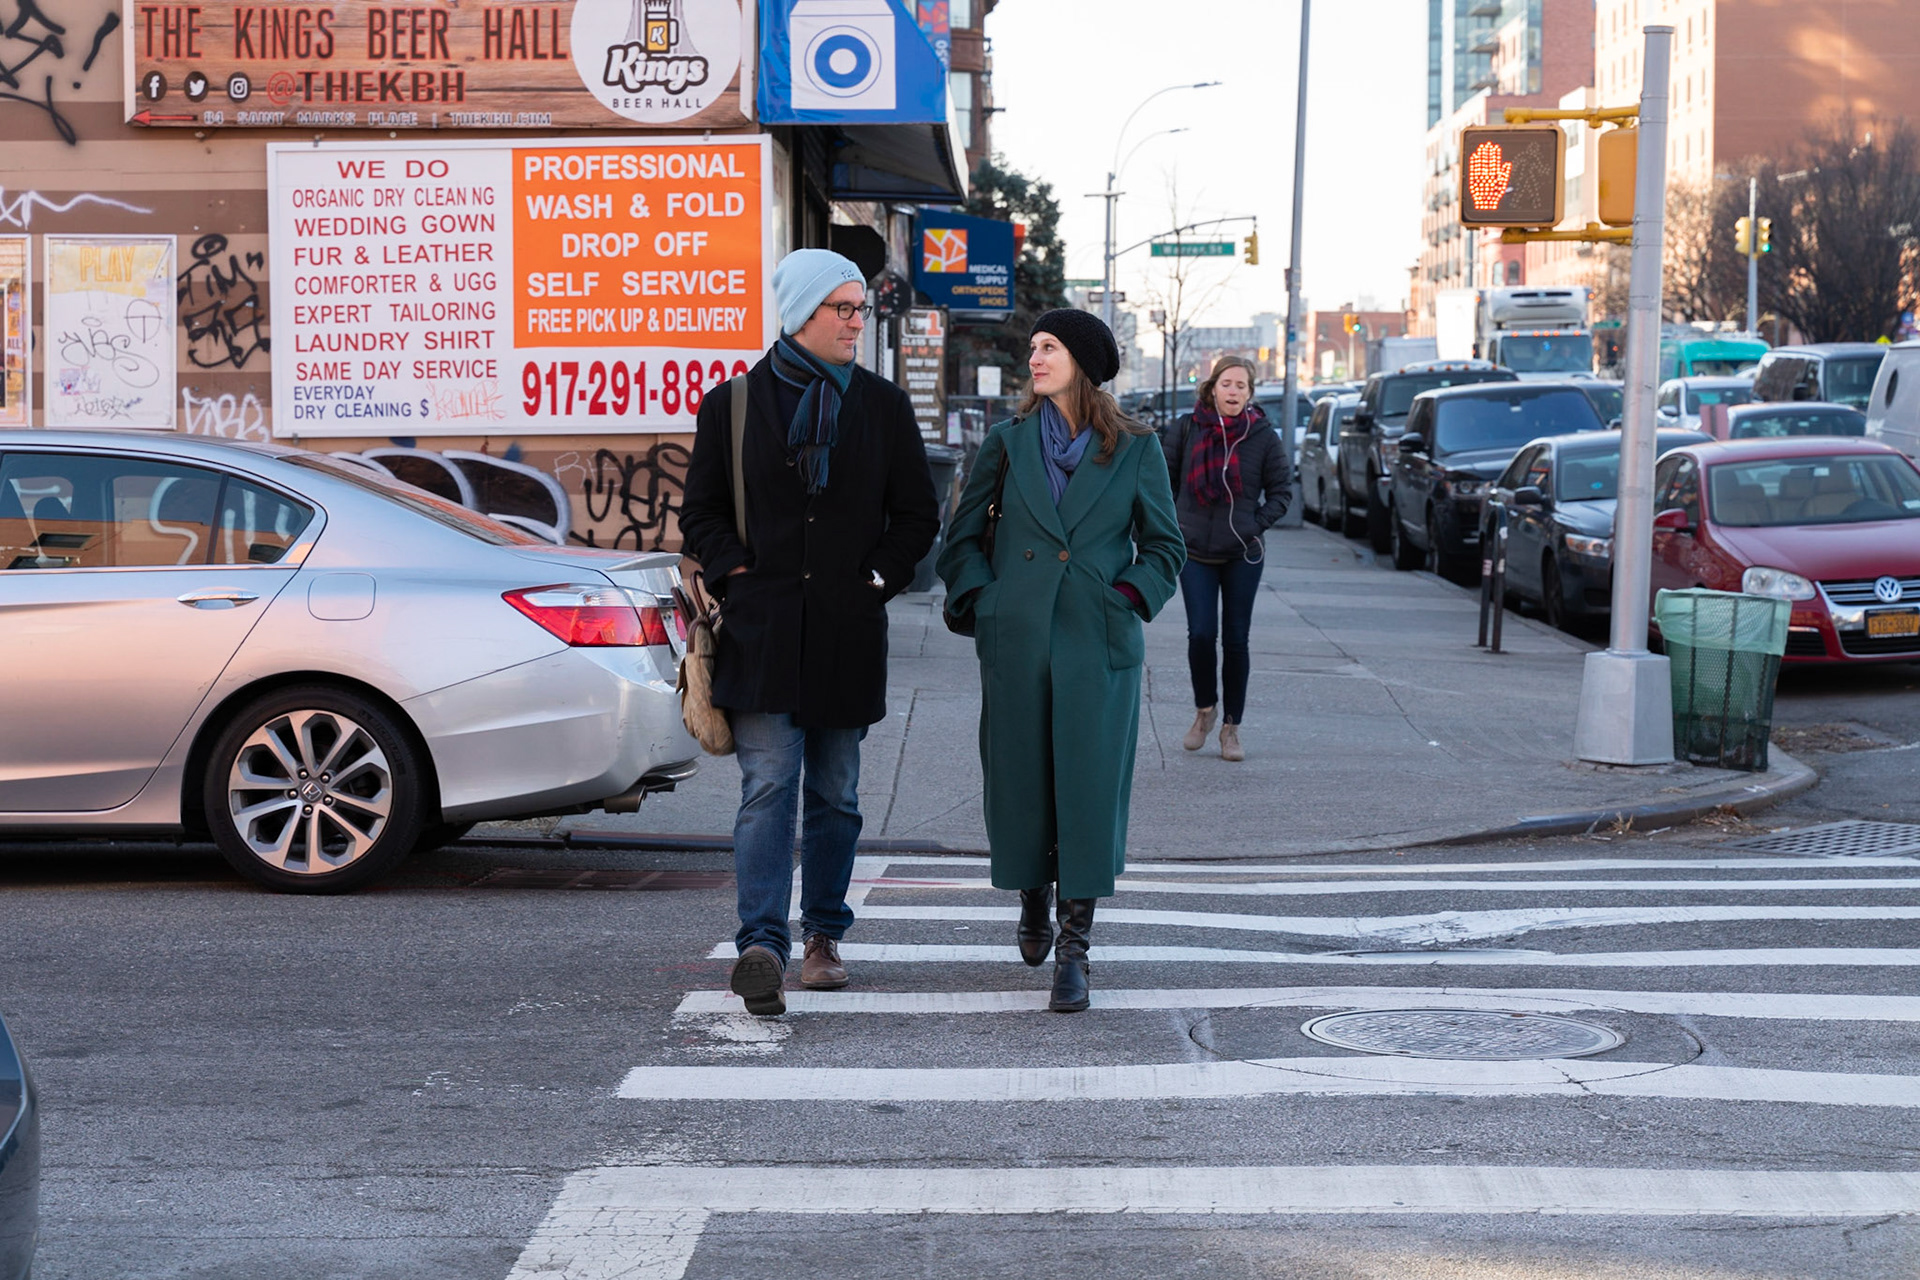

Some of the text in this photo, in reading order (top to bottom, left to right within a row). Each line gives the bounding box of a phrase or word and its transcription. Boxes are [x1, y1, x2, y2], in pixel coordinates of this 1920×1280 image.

[141, 6, 569, 61] THE KINGS BEER HALL
[604, 42, 709, 95] Kings
[267, 70, 466, 105] @THEKBH
[612, 98, 702, 108] BEER HALL
[237, 111, 285, 124] SAINT
[297, 112, 356, 125] MARKS
[368, 112, 418, 126] PLACE
[337, 159, 450, 178] WE DO
[524, 153, 745, 180] PROFESSIONAL
[292, 188, 364, 208] ORGANIC
[373, 188, 405, 207] DRY
[526, 192, 745, 219] WASH & FOLD
[294, 213, 495, 237] WEDDING GOWN
[294, 243, 494, 266] FUR & LEATHER
[562, 231, 708, 258] DROP OFF
[79, 246, 136, 283] PLAY
[968, 264, 1008, 275] MEDICAL
[294, 271, 497, 296] COMFORTER & UGG
[527, 269, 746, 298] SELF SERVICE
[951, 285, 1008, 295] ORTHOPEDIC
[975, 275, 1009, 285] SUPPLY
[294, 301, 496, 324] EXPERT TAILORING
[978, 297, 1008, 307] SHOES
[528, 307, 747, 333] FREE PICK UP & DELIVERY
[295, 330, 495, 352] LAUNDRY SHIRT
[296, 359, 498, 381] SAME DAY SERVICE
[294, 385, 375, 400] EVERYDAY
[294, 404, 326, 419] DRY
[334, 402, 412, 419] CLEANING
